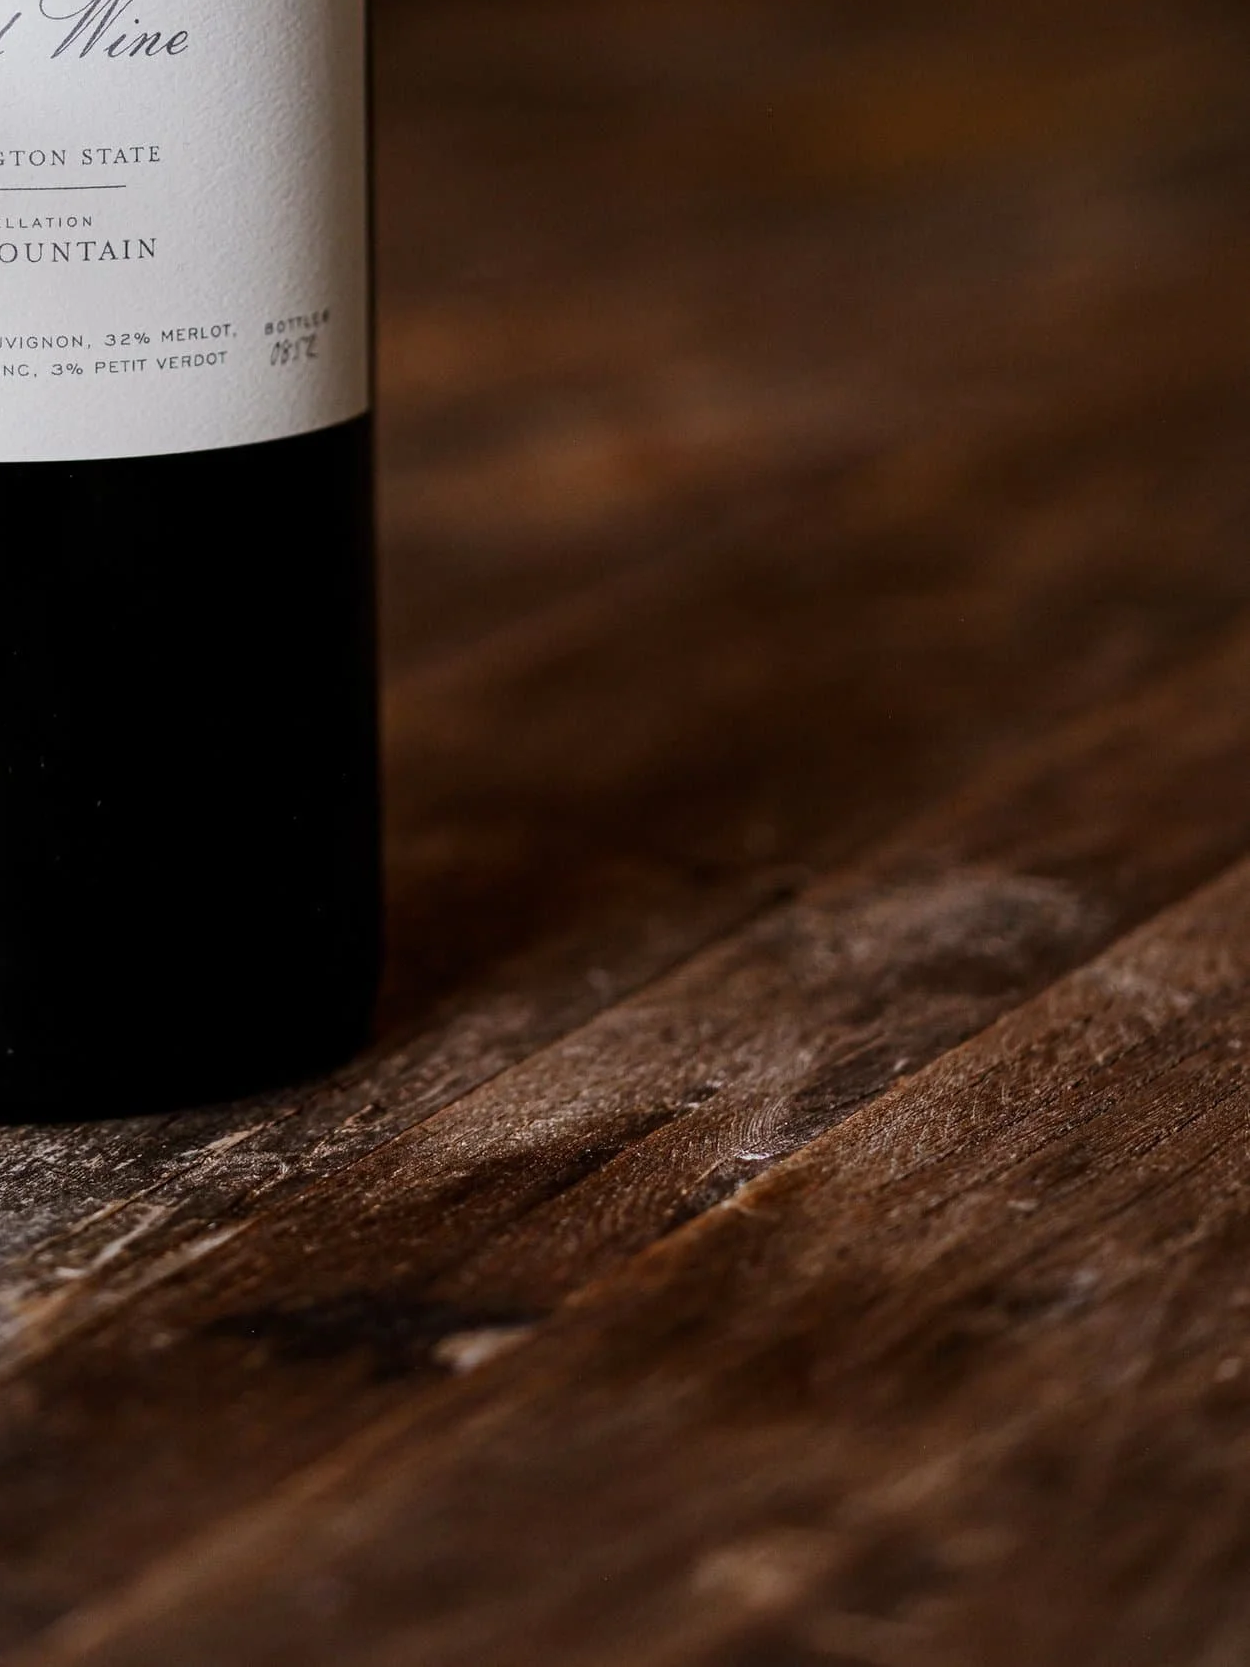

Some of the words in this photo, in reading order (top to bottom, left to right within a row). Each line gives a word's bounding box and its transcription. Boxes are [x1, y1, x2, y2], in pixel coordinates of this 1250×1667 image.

[82, 146, 160, 165] STATE
[104, 332, 151, 347] 32%
[51, 363, 84, 376] 3%
[95, 358, 147, 374] PETIT
[156, 351, 227, 370] VERDOT
